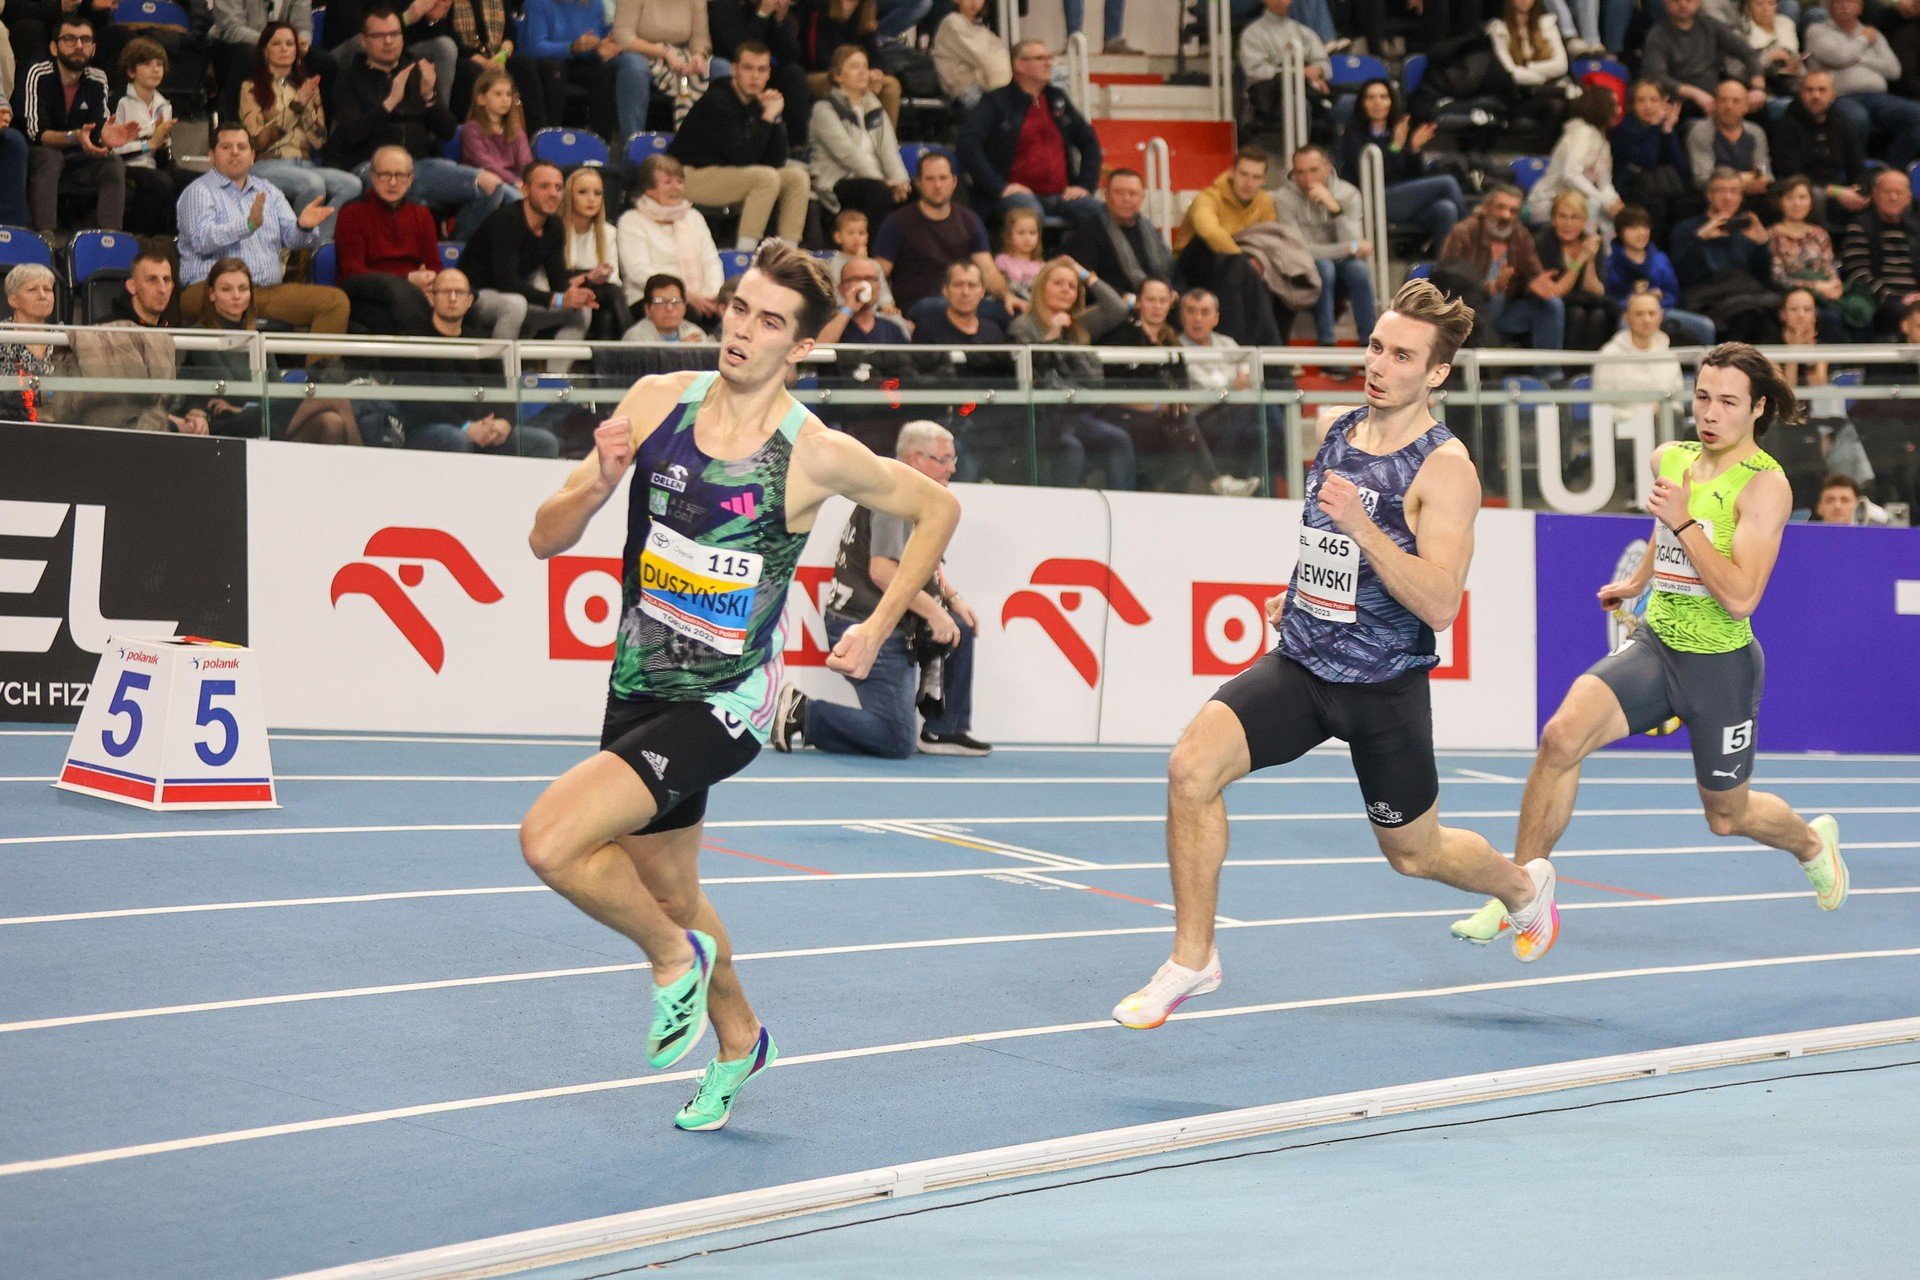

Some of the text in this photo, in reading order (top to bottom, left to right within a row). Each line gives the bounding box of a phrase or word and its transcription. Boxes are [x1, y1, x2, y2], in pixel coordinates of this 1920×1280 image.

[653, 475, 684, 491] ORLEN
[1318, 536, 1350, 557] 465
[708, 554, 750, 577] 115
[644, 563, 749, 618] DUSZYŃSKI
[1675, 583, 1692, 592] 2023
[1314, 607, 1331, 617] 2023
[693, 627, 715, 643] 2023
[719, 629, 739, 639] Polski
[125, 650, 160, 665] polanik
[202, 657, 240, 671] polanik
[101, 670, 152, 758] 5
[194, 679, 240, 767] 5
[1730, 725, 1748, 750] 5
